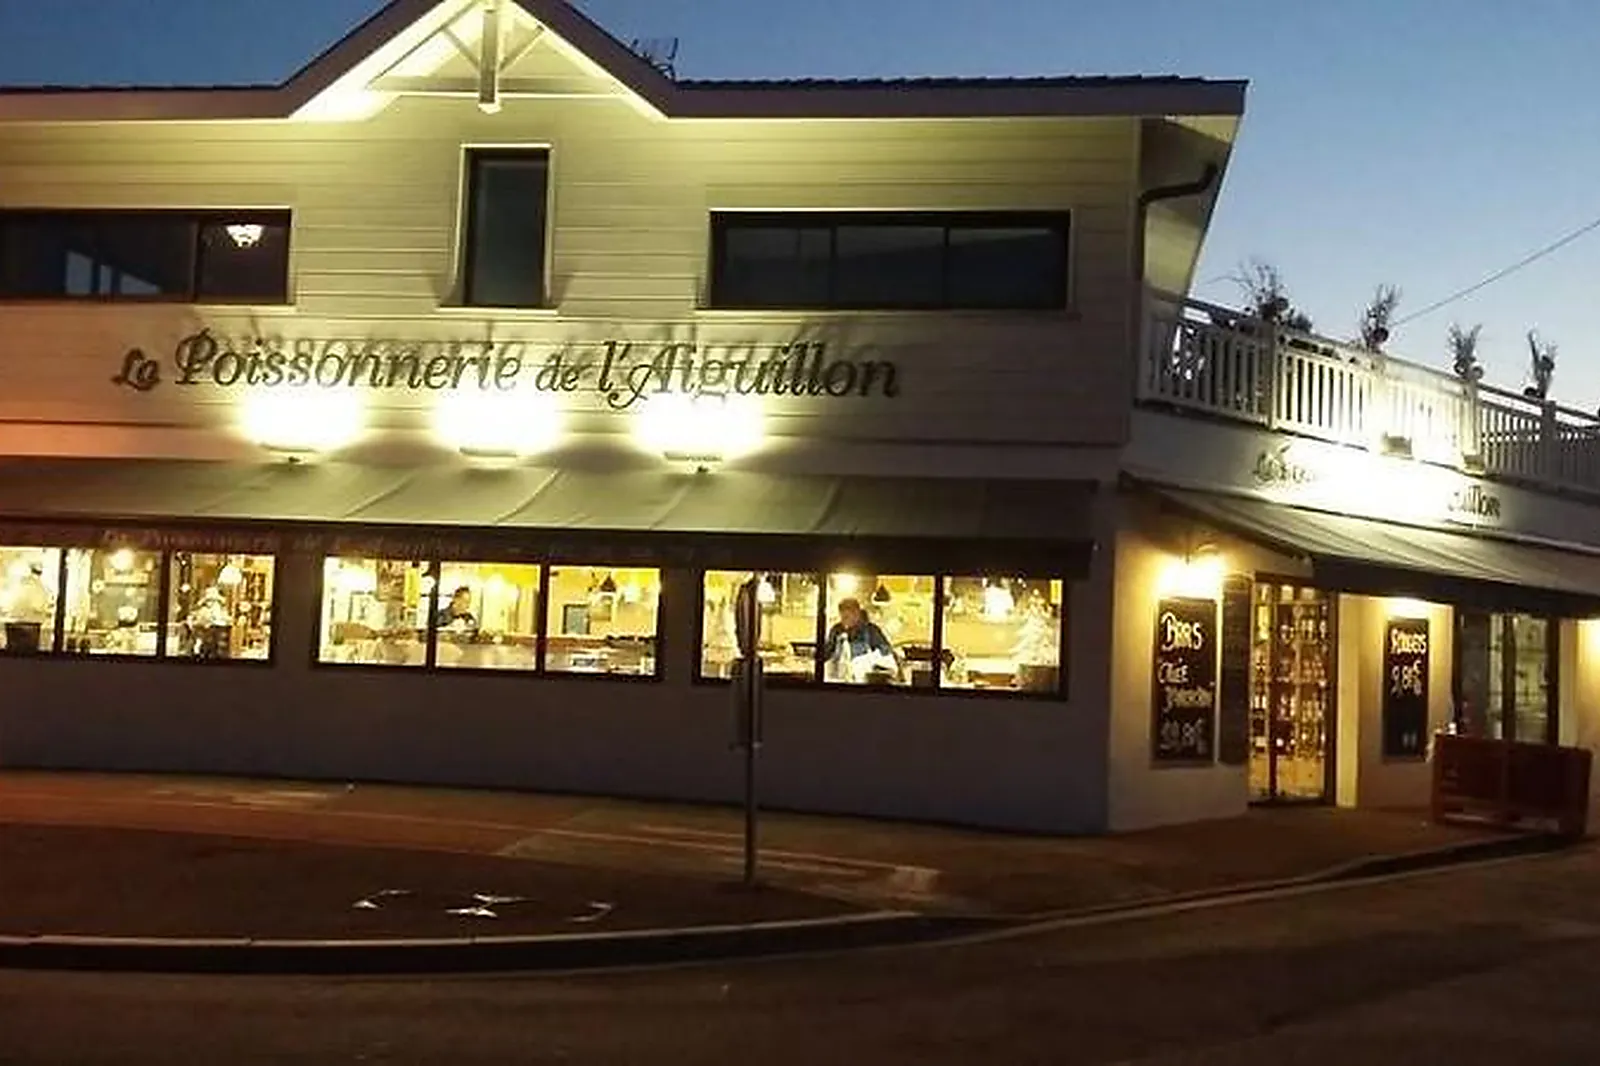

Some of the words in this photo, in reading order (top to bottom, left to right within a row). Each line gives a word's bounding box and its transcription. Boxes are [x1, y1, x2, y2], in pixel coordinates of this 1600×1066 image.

[111, 347, 162, 392] La
[173, 328, 520, 391] Poissonnerie
[535, 351, 579, 392] de
[599, 340, 899, 411] l'Aiguillon
